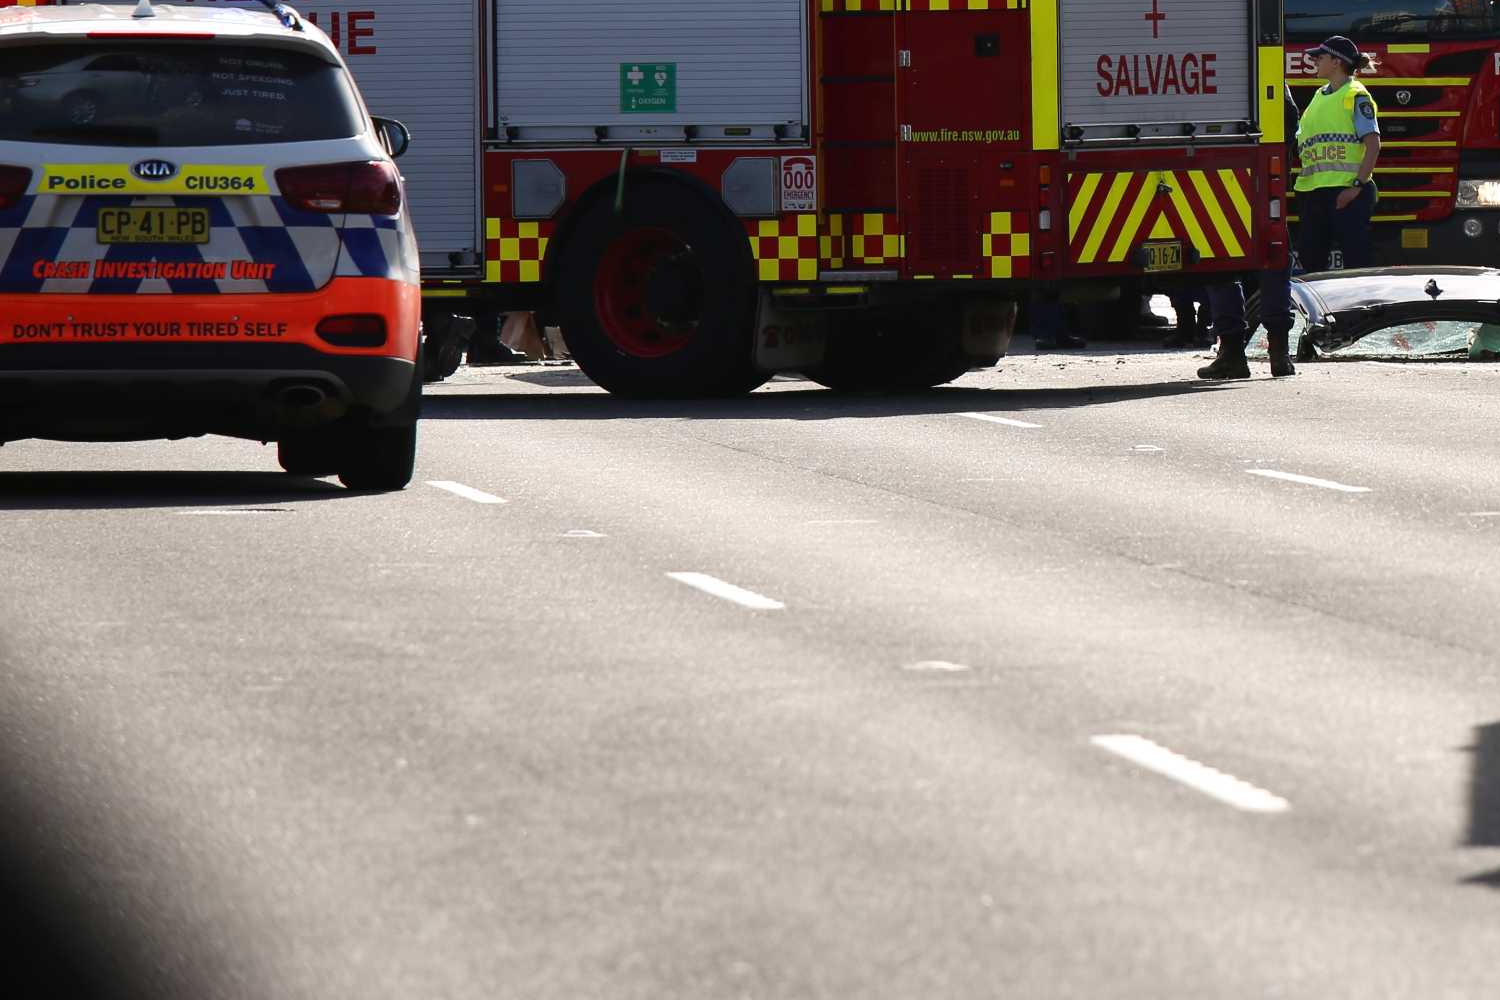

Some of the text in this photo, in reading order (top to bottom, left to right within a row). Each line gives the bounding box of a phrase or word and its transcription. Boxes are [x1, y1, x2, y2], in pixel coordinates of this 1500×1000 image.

[1096, 53, 1218, 97] SALVAGE
[638, 97, 666, 105] OXYGEN
[911, 128, 1020, 144] www.fire.nsw.gov.au
[139, 162, 172, 176] KIA
[48, 175, 127, 190] Police
[185, 175, 255, 190] CIU364
[784, 171, 814, 189] 000
[31, 259, 275, 280] CRASH INVESTIGATION UNIT
[12, 322, 288, 339] DON'T TRUST YOUR TIRED SELF
